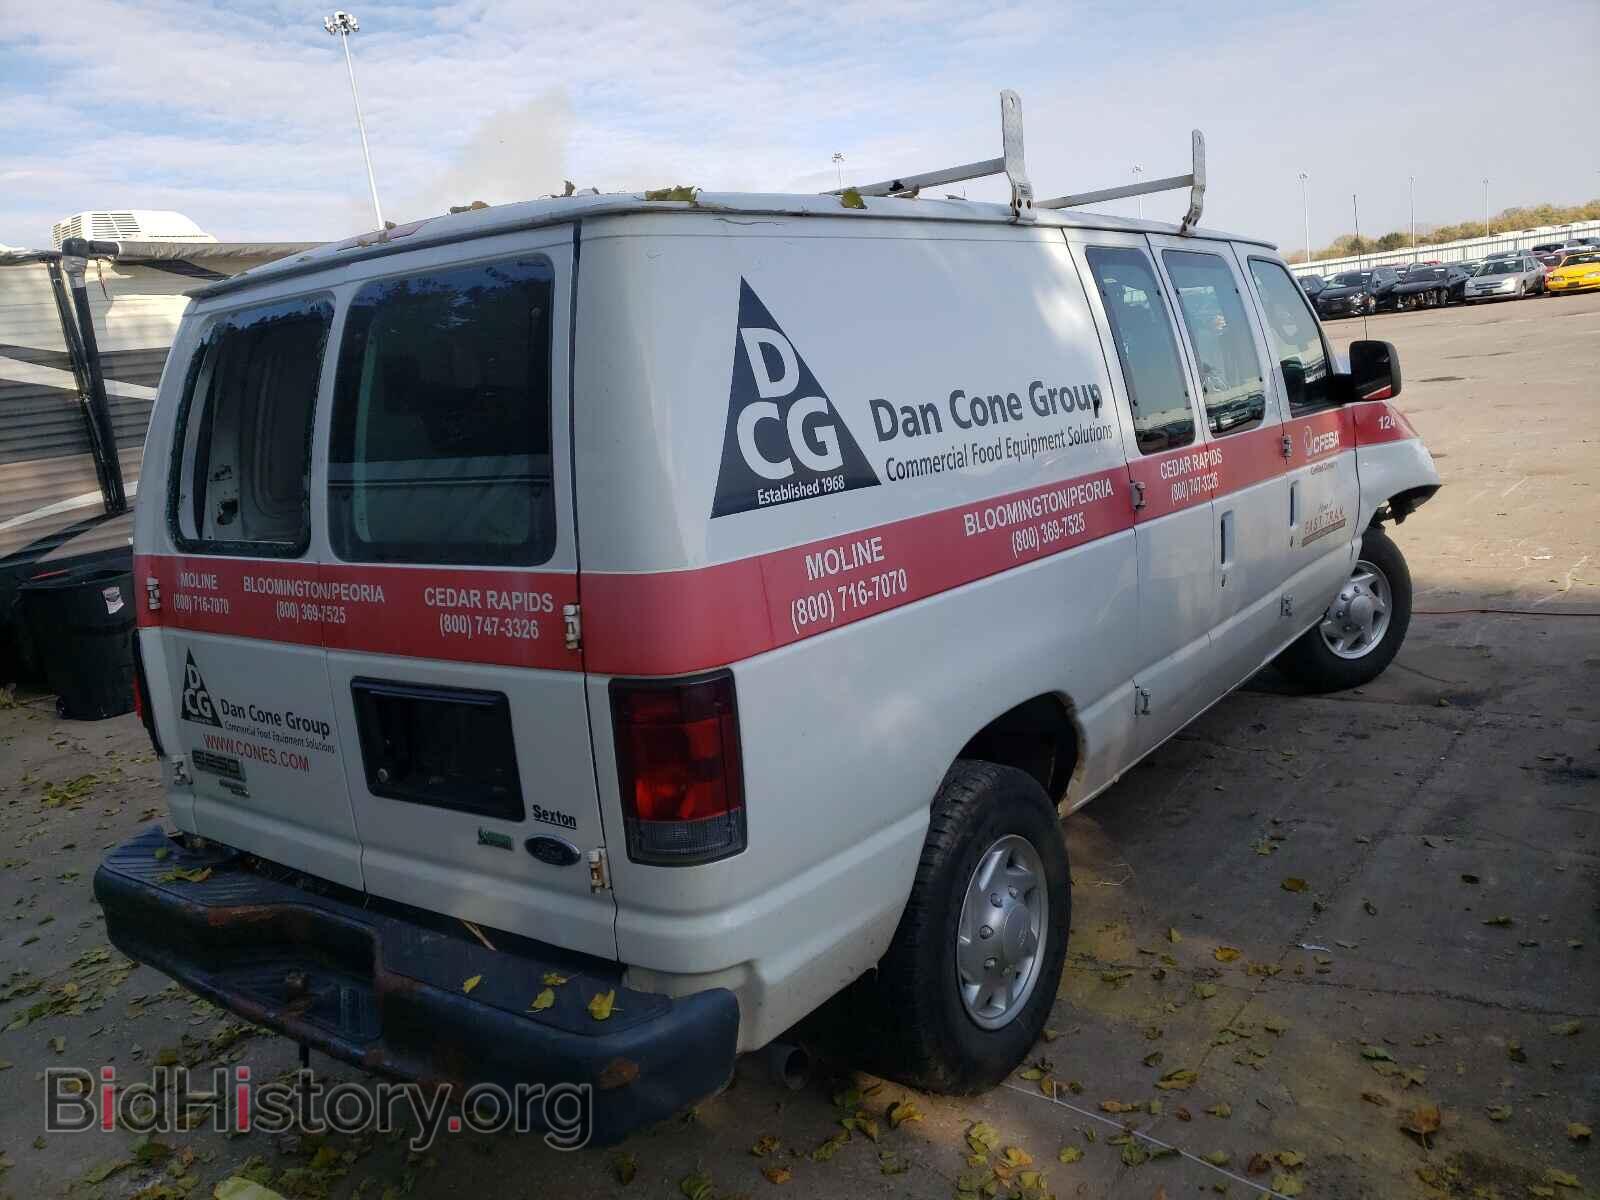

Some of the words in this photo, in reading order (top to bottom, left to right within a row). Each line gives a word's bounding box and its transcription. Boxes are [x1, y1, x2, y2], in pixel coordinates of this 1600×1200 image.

[740, 327, 800, 399] D
[869, 398, 943, 442] Dan
[949, 389, 1024, 430] Cone
[1028, 380, 1103, 418] Group
[736, 396, 844, 480] CG
[885, 446, 969, 482] Commercial
[972, 437, 1002, 466] Food
[1005, 428, 1066, 463] Equipment
[1067, 421, 1113, 447] Solutions
[1160, 456, 1192, 480] CEDAR
[1192, 447, 1223, 471] RAPIDS
[757, 480, 820, 505] Established
[822, 475, 845, 496] 1968
[1171, 480, 1189, 504] (800)
[1190, 471, 1219, 496] 747-3326
[963, 477, 1114, 537] BLOOMINGTON/PEORIA
[1011, 530, 1040, 558] (800)
[1040, 512, 1086, 545] 369-7525
[805, 536, 885, 580] MOLINE
[179, 572, 219, 590] MOLINE
[243, 575, 385, 603] BLOOMINGTON/PEORIA
[173, 592, 192, 614] (800)
[192, 595, 229, 615] 716-7070
[276, 600, 299, 624] (800)
[302, 604, 346, 624] 369-7525
[424, 587, 482, 609] CEDAR
[486, 590, 554, 613] RAPIDS
[790, 591, 836, 634] (800)
[837, 568, 908, 613] 716-7070
[440, 613, 472, 640] (800)
[474, 616, 540, 639] 747-3326
[186, 663, 201, 689] D
[220, 699, 246, 720] Dan
[249, 704, 282, 727] Cone
[285, 711, 331, 740] Group
[203, 734, 310, 773] WWW.CONES.COM
[532, 804, 577, 828] Sexton
